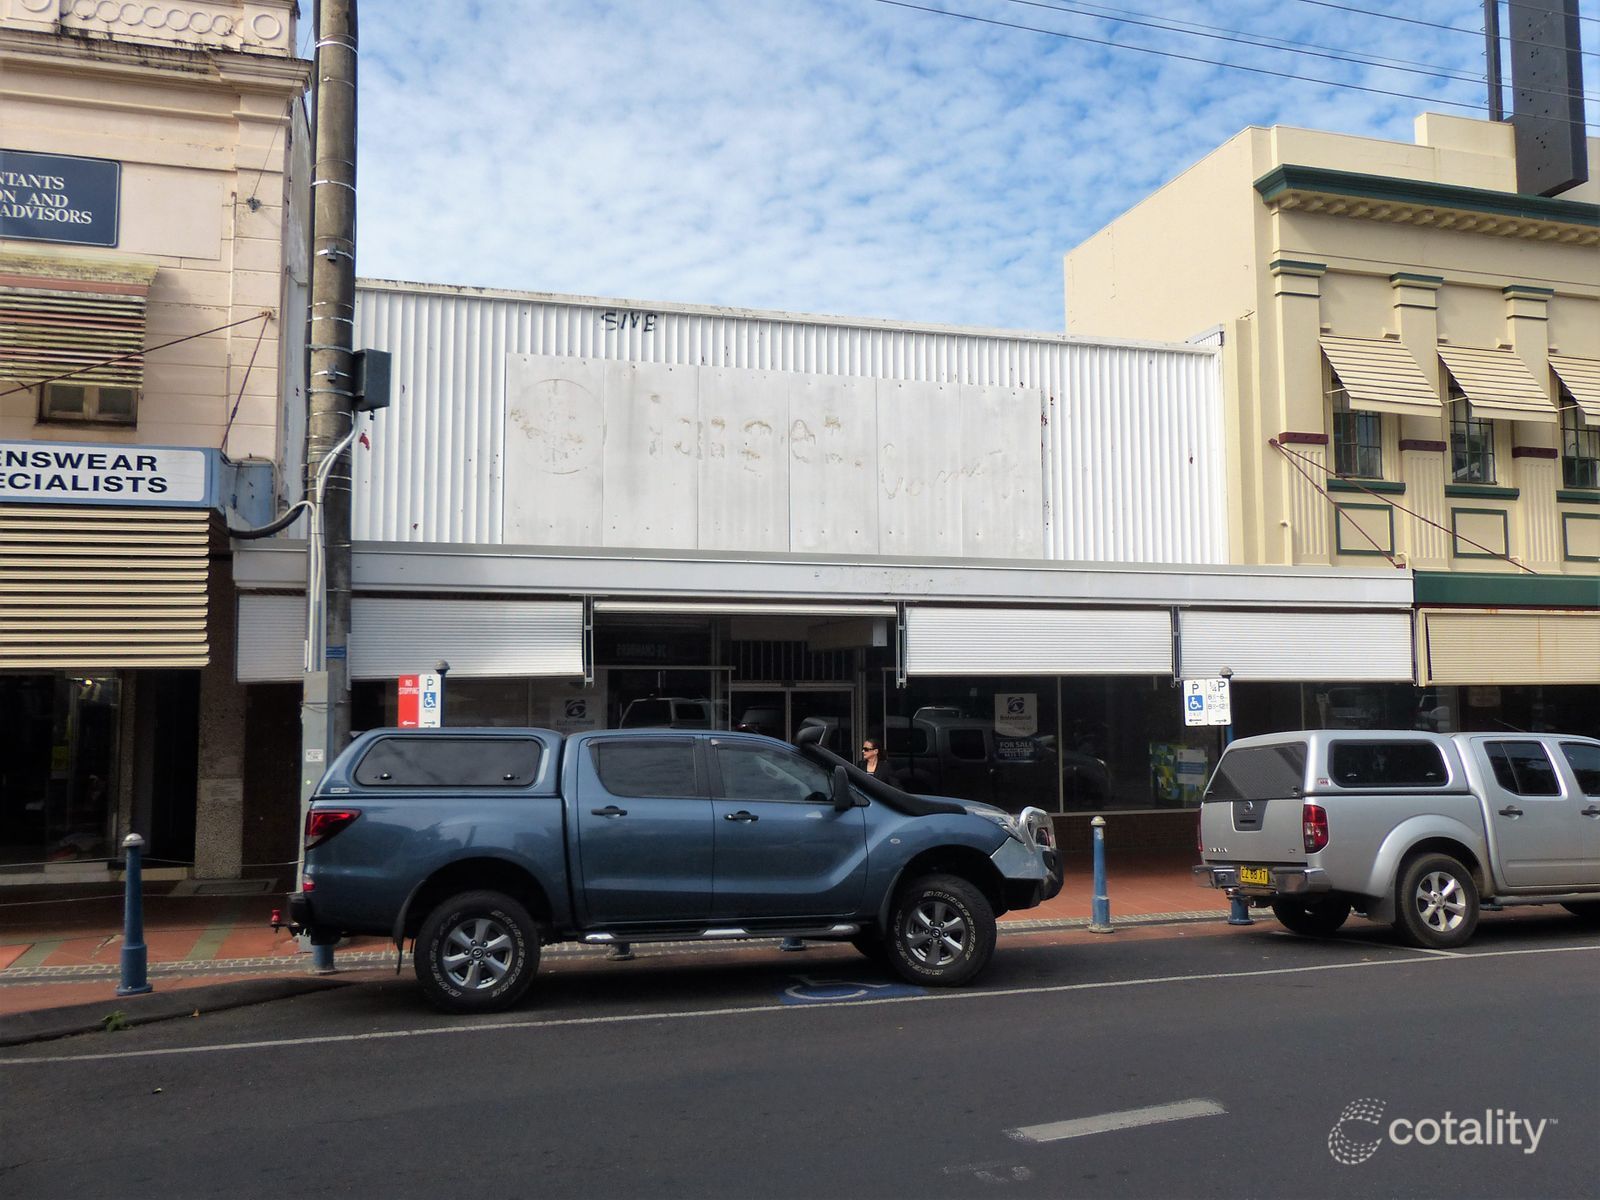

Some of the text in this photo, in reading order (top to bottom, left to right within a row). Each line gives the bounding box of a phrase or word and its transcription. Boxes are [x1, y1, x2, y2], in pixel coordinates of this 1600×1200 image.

[0, 189, 69, 208] N AND
[0, 204, 92, 224] ADVISORS
[0, 450, 157, 472] NSWEAR
[426, 678, 434, 691] P
[1192, 683, 1200, 695] P
